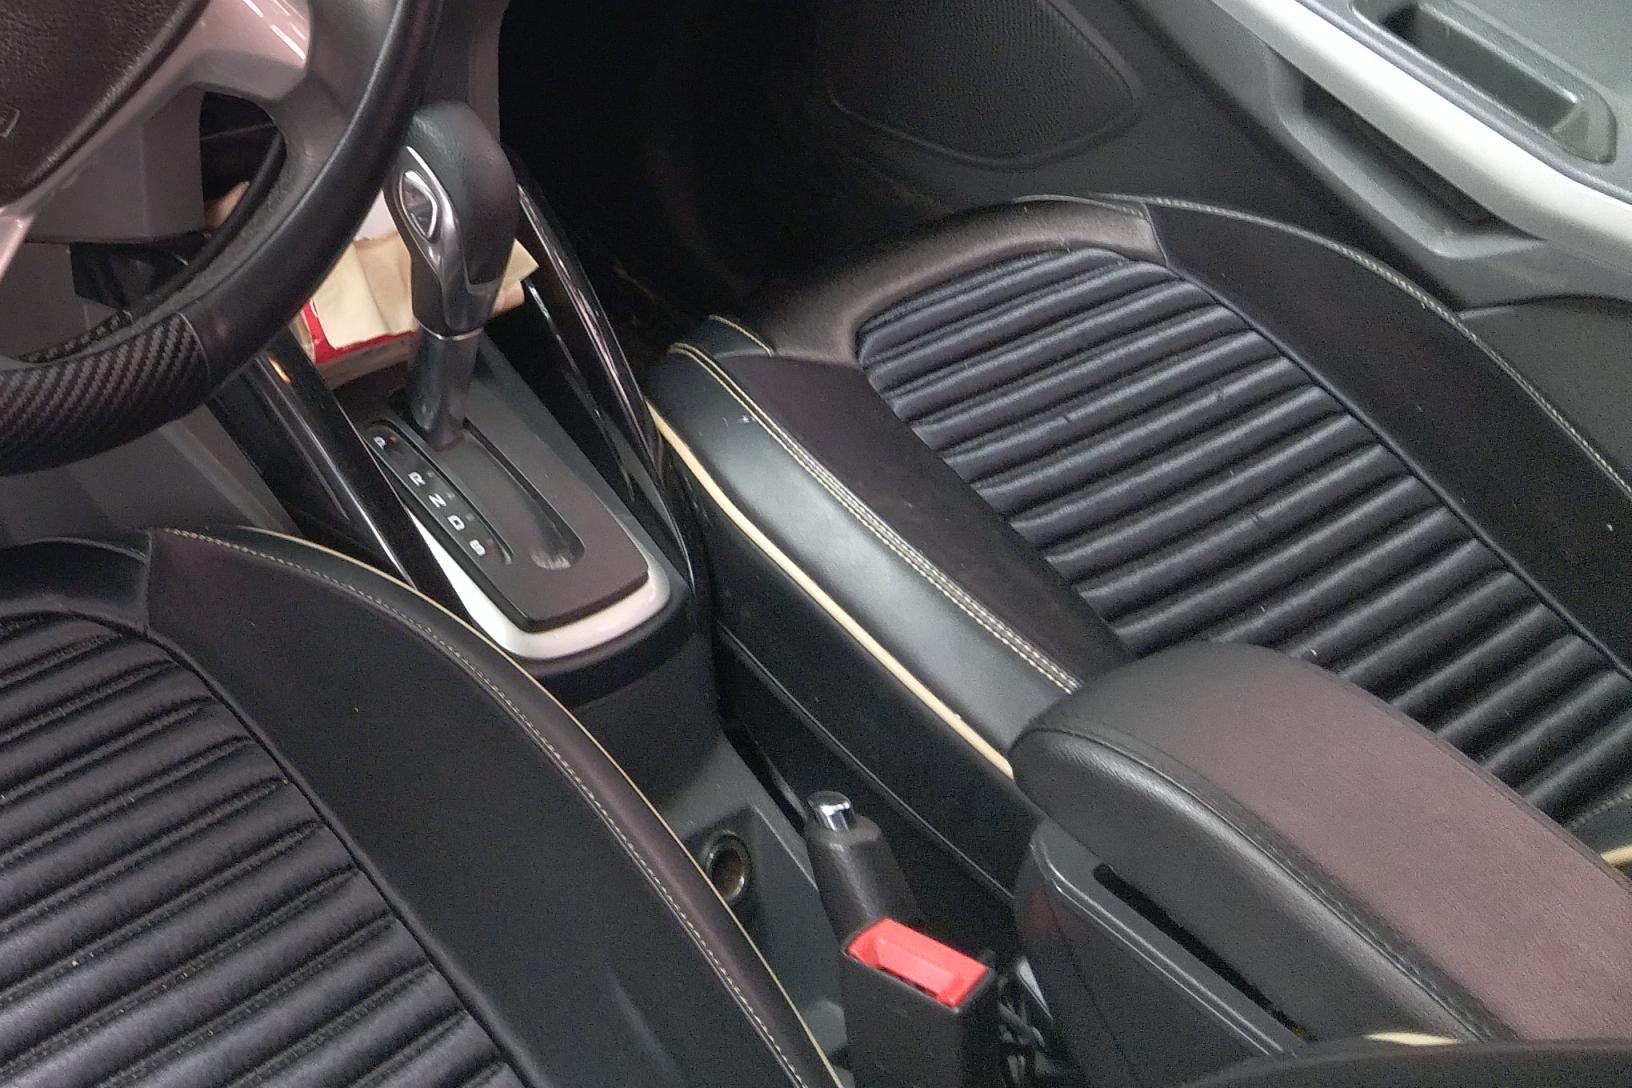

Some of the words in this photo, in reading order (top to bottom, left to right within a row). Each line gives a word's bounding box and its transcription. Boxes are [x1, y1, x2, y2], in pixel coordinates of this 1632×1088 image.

[373, 436, 387, 450] P
[408, 471, 426, 487] R
[429, 492, 447, 509] N
[447, 514, 465, 531] D
